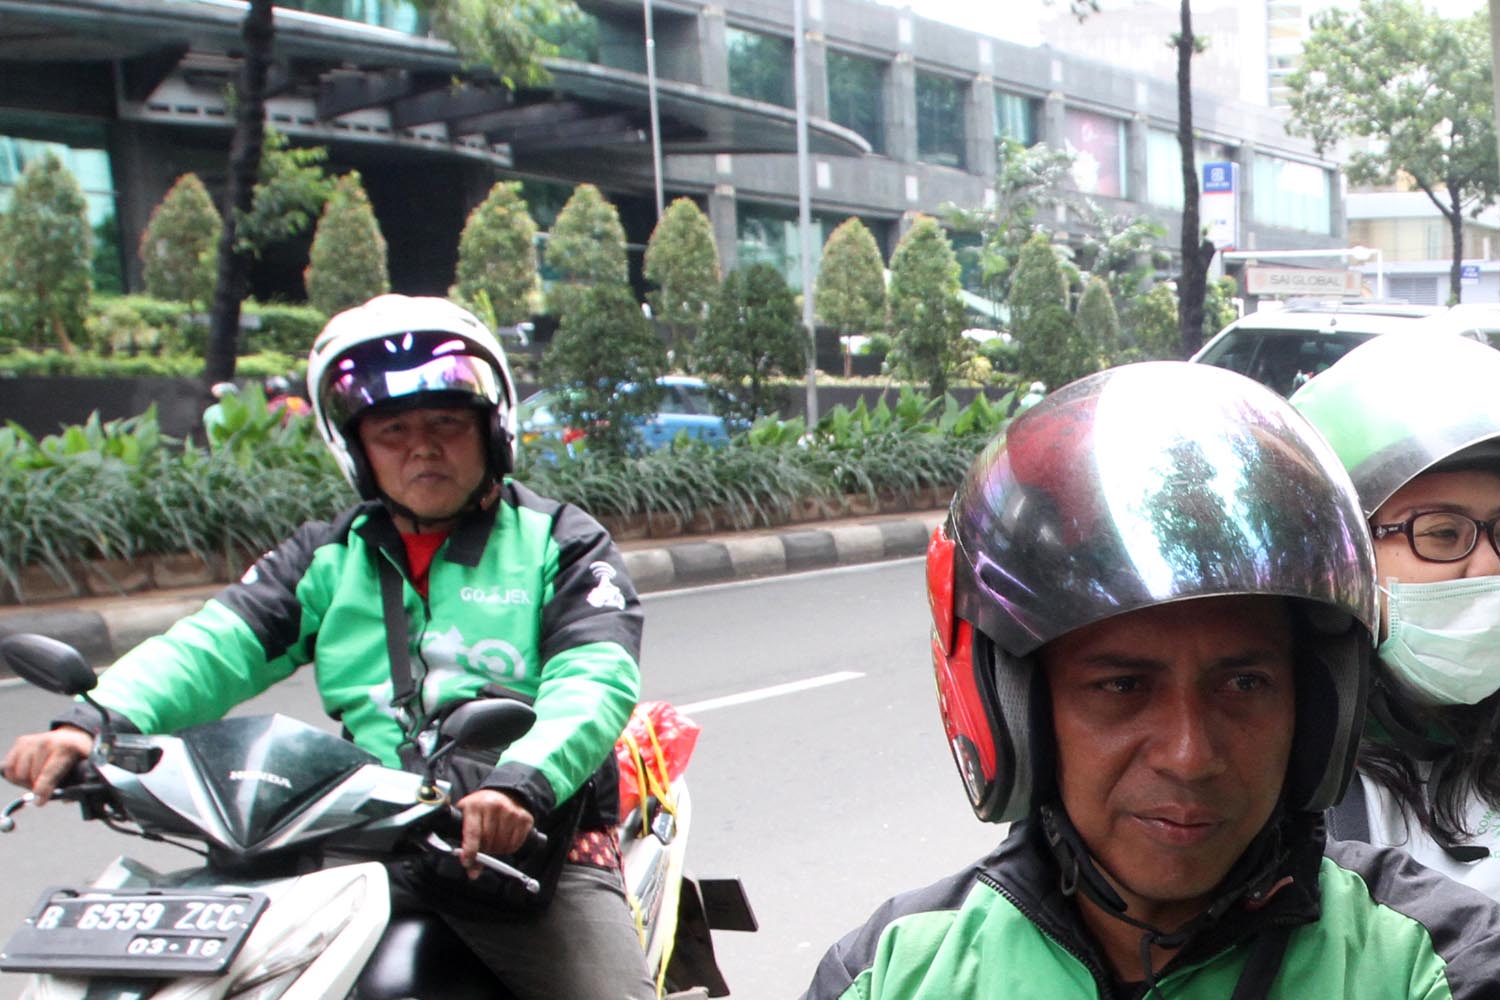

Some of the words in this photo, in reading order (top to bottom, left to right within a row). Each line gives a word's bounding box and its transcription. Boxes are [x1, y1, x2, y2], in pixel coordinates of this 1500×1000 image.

[1292, 274, 1341, 288] GLOBAL
[228, 770, 293, 788] HONDA
[77, 902, 165, 930] 6559
[174, 902, 244, 931] ZCC
